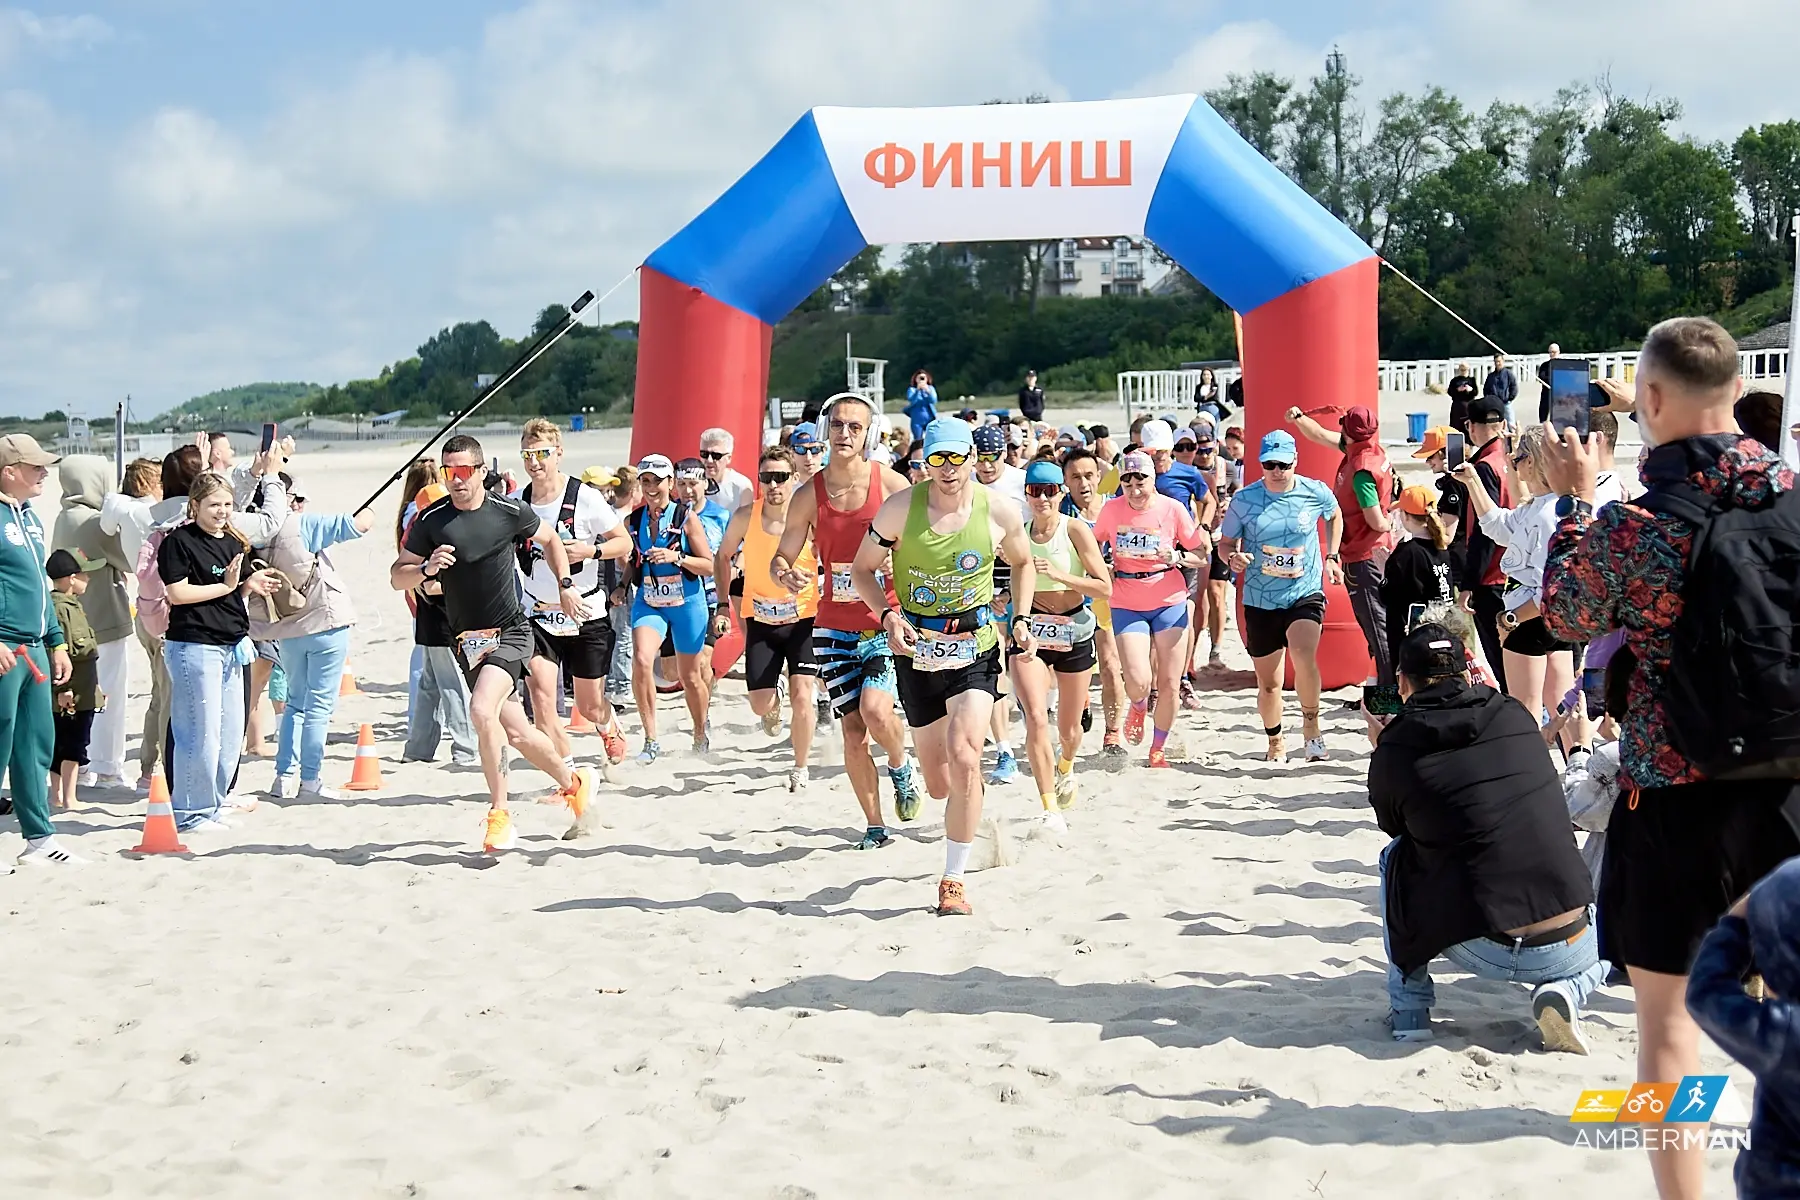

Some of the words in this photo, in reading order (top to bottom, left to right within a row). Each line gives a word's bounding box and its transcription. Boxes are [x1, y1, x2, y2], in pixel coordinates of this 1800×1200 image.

[864, 140, 1131, 188] ФИНИШ
[1130, 535, 1147, 547] 41
[1276, 556, 1294, 566] 84
[909, 569, 962, 581] NEVER
[924, 580, 962, 588] GIVE
[771, 606, 778, 615] 1
[546, 613, 565, 625] 46
[1035, 624, 1057, 638] 73
[933, 642, 959, 657] 52
